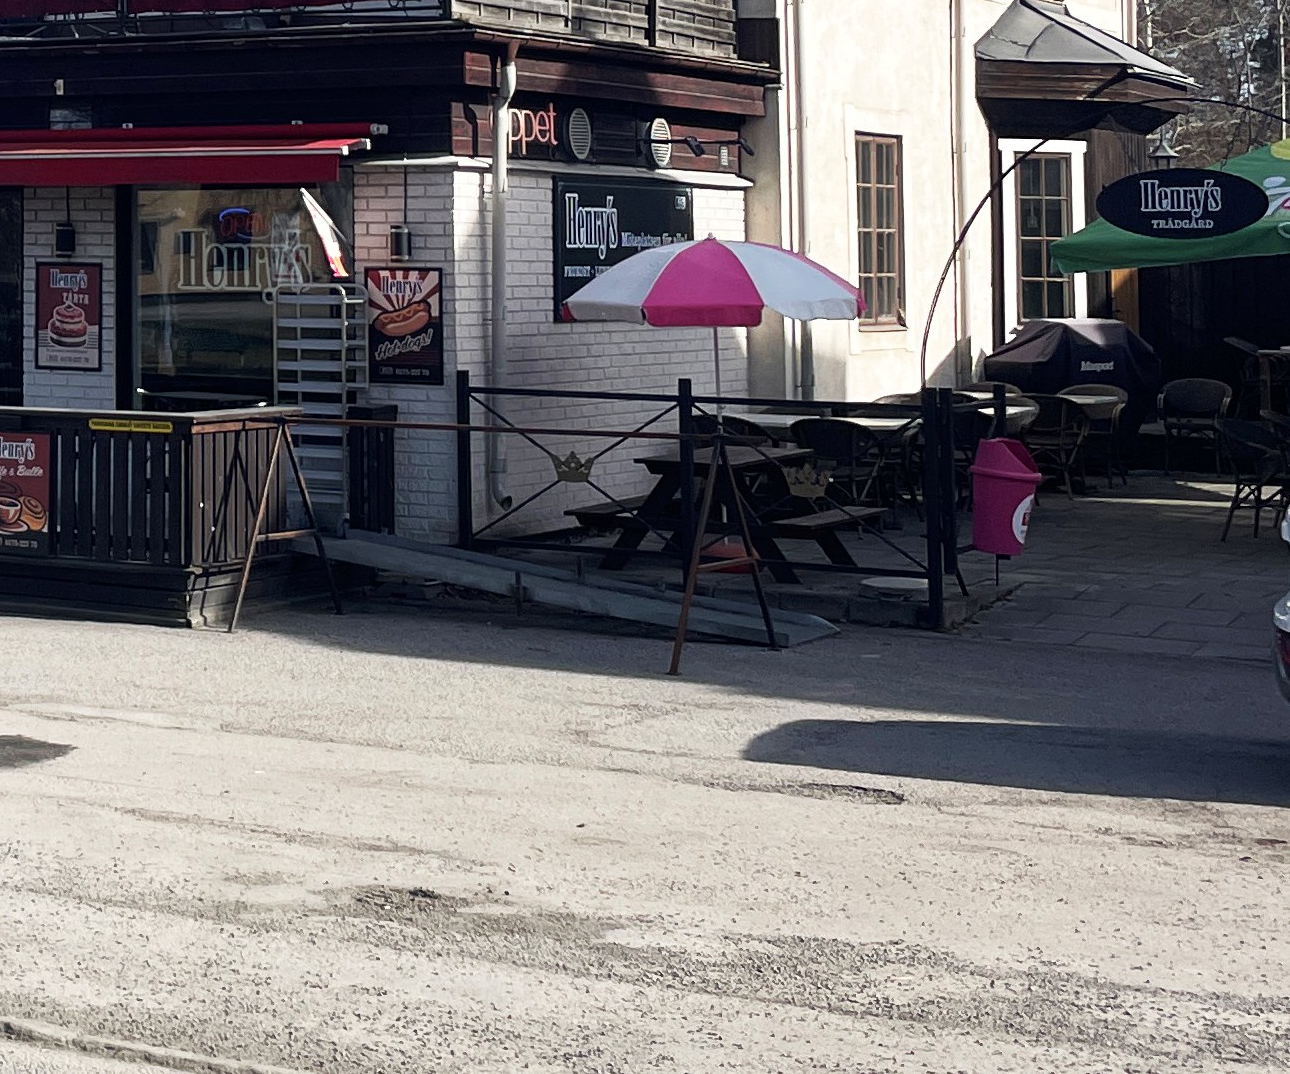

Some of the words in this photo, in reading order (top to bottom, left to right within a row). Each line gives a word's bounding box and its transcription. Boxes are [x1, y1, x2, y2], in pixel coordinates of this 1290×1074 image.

[490, 102, 558, 154] ppet
[1140, 179, 1222, 218] Henry's
[565, 193, 618, 260] Henry's
[50, 269, 87, 292] Henry's
[178, 228, 313, 304] Henry's
[381, 275, 423, 297] Henry's
